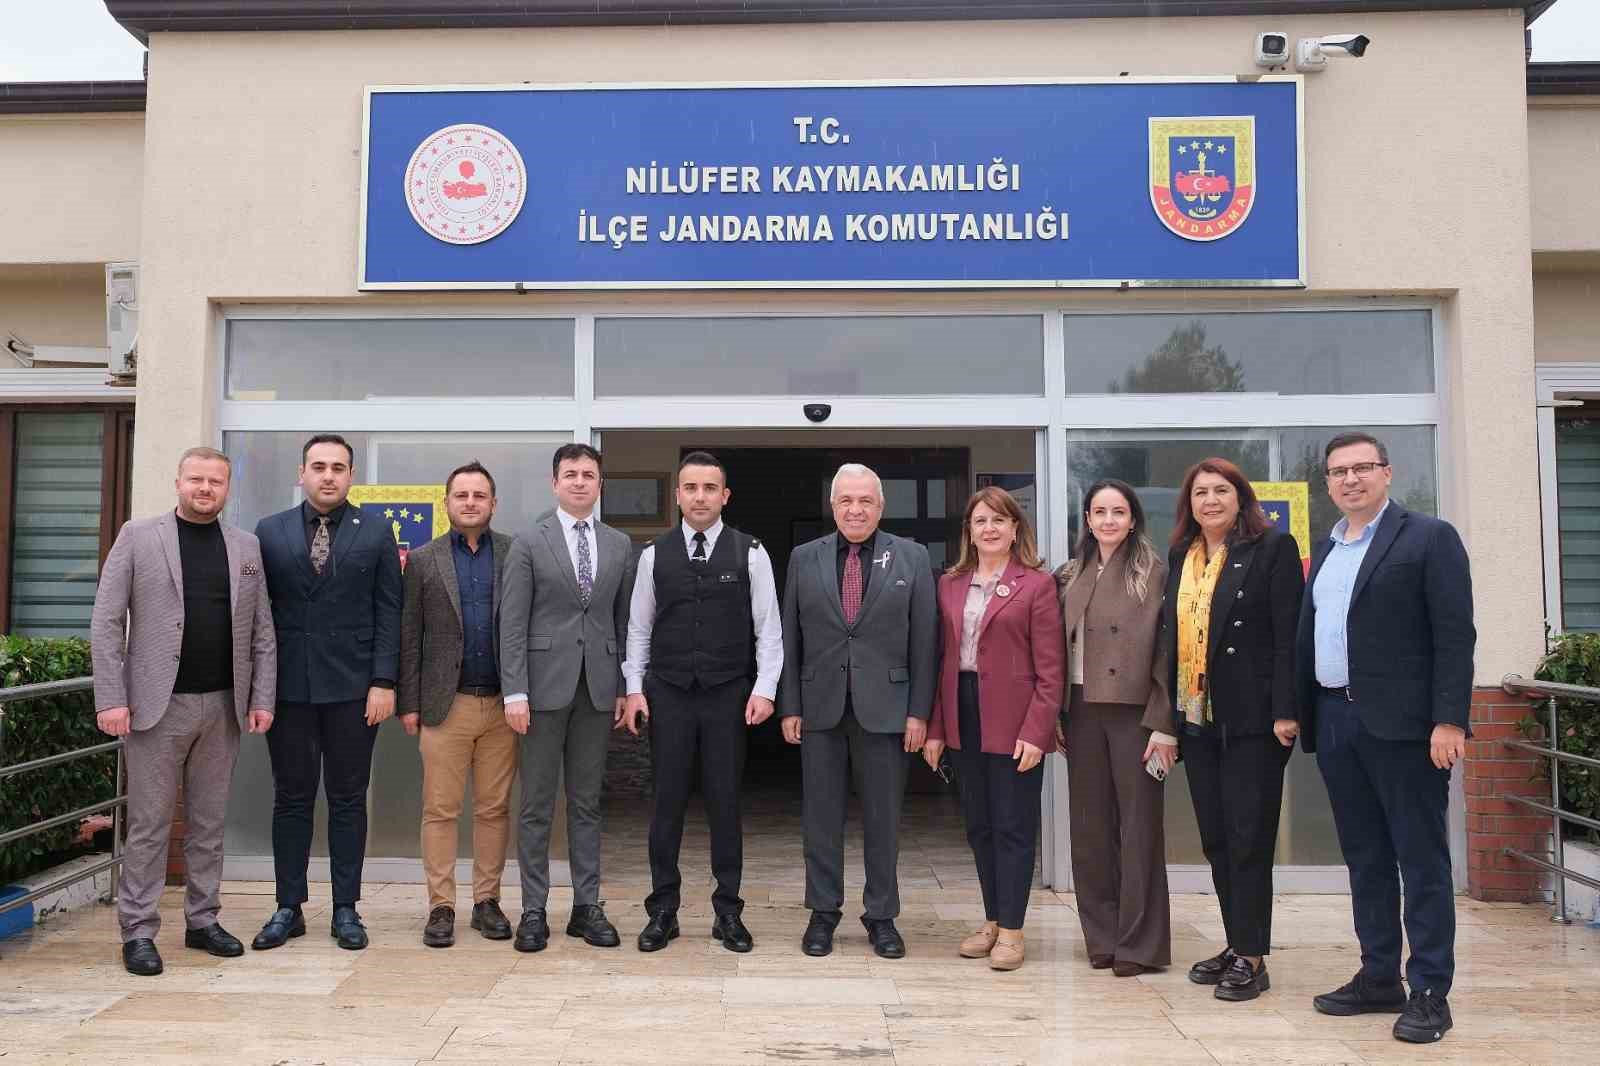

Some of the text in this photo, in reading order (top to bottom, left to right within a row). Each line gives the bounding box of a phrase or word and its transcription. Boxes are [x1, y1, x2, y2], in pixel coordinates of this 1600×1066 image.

[793, 116, 850, 144] T.C.
[626, 156, 1020, 194] NİLÜFER KAYMAKAMLIĞI
[578, 205, 1070, 249] İLÇE JANDARMA KOMUTANLIĞI
[1159, 198, 1247, 234] JANDARMA
